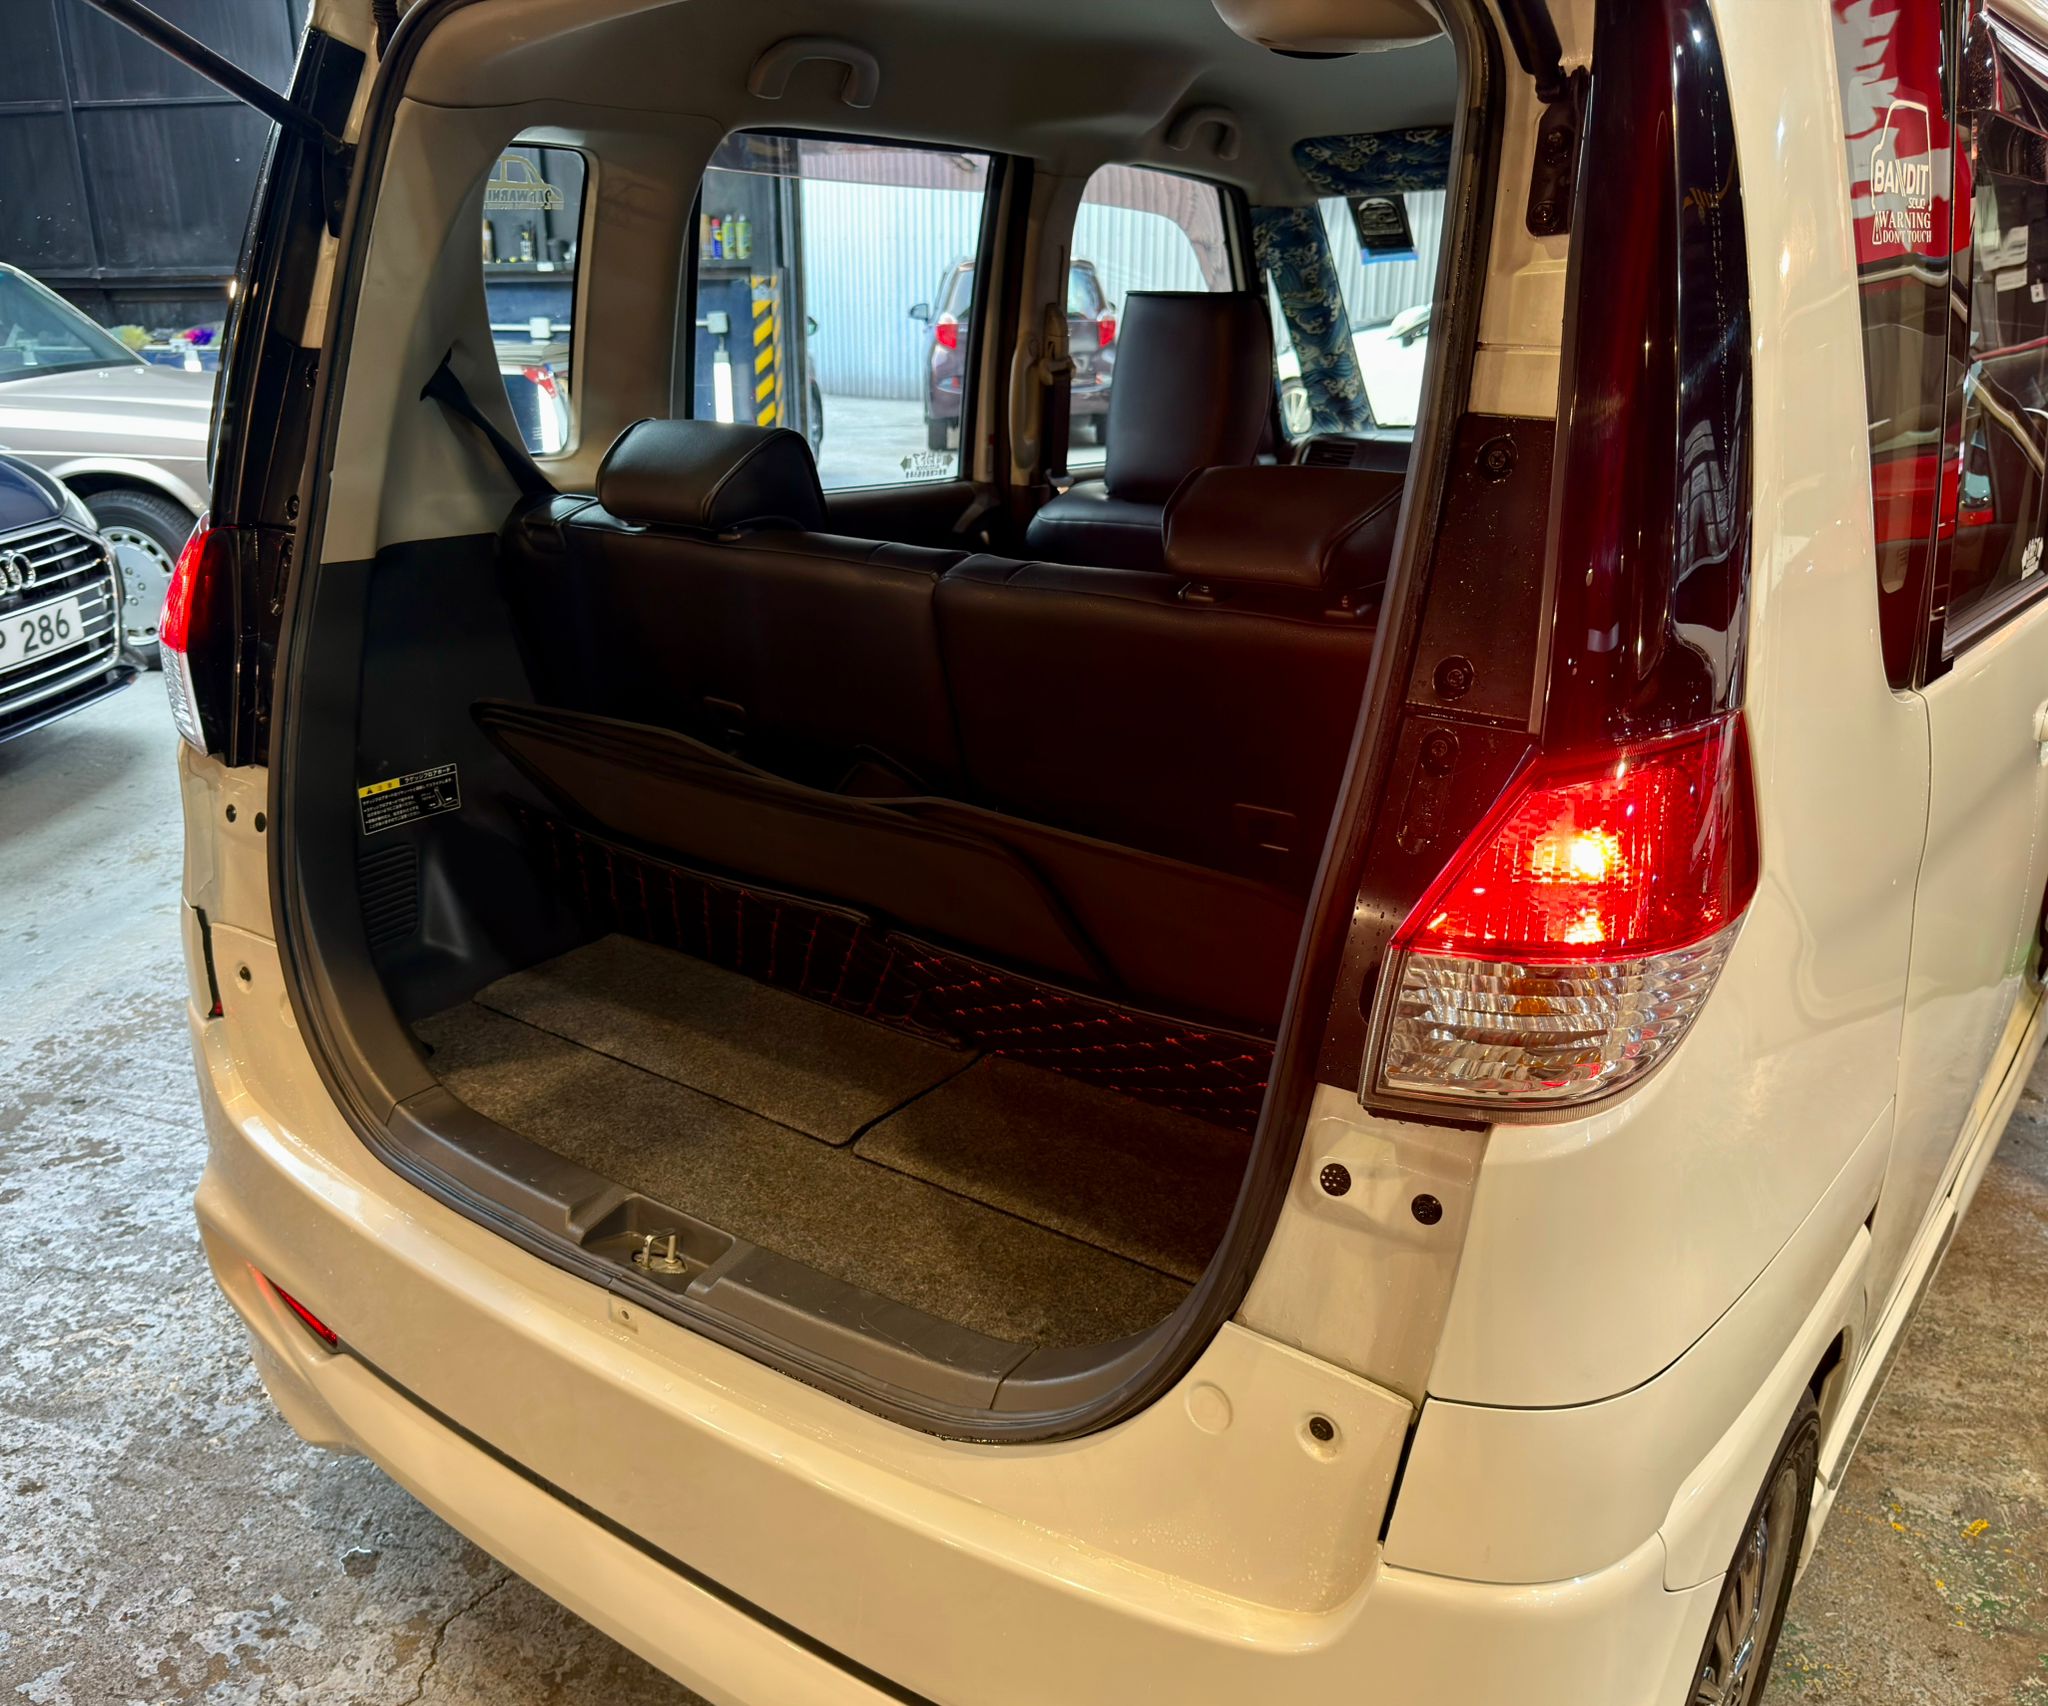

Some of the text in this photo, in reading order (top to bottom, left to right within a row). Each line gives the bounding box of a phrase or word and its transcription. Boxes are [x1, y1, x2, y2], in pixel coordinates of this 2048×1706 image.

[1874, 159, 1929, 197] BANDIT
[1879, 210, 1931, 229] WARNING
[1907, 230, 1932, 243] TOUCH
[20, 608, 70, 654] 286
